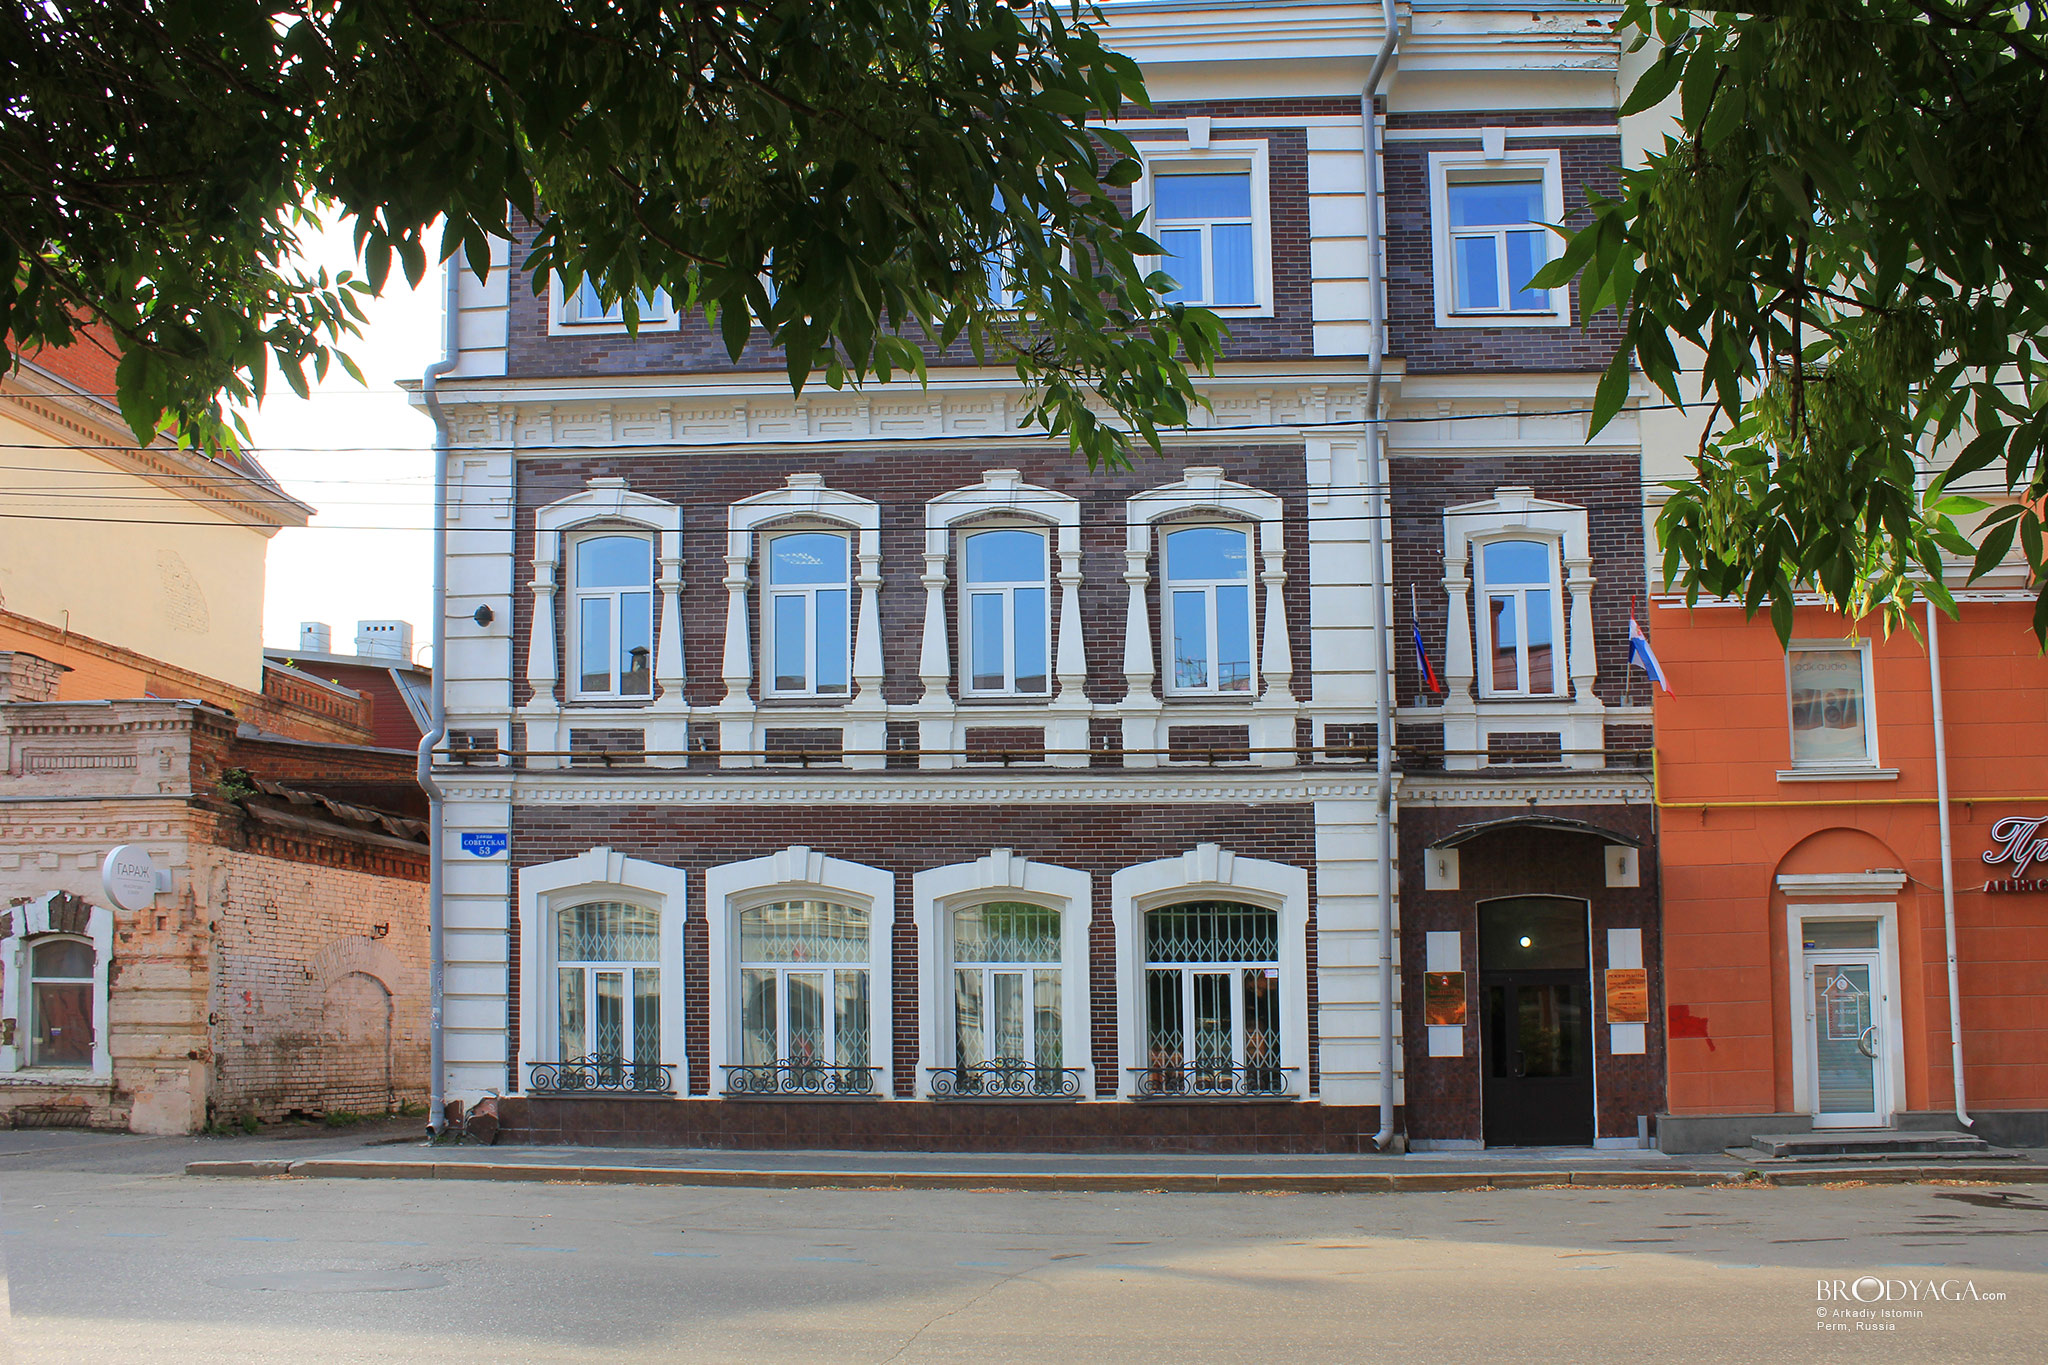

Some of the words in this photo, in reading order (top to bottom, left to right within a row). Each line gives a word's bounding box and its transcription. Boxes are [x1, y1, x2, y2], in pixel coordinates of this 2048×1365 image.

[463, 839, 506, 847] СОВЕТСКАЯ
[479, 846, 491, 855] 53
[117, 862, 150, 878] ГАРАЖ
